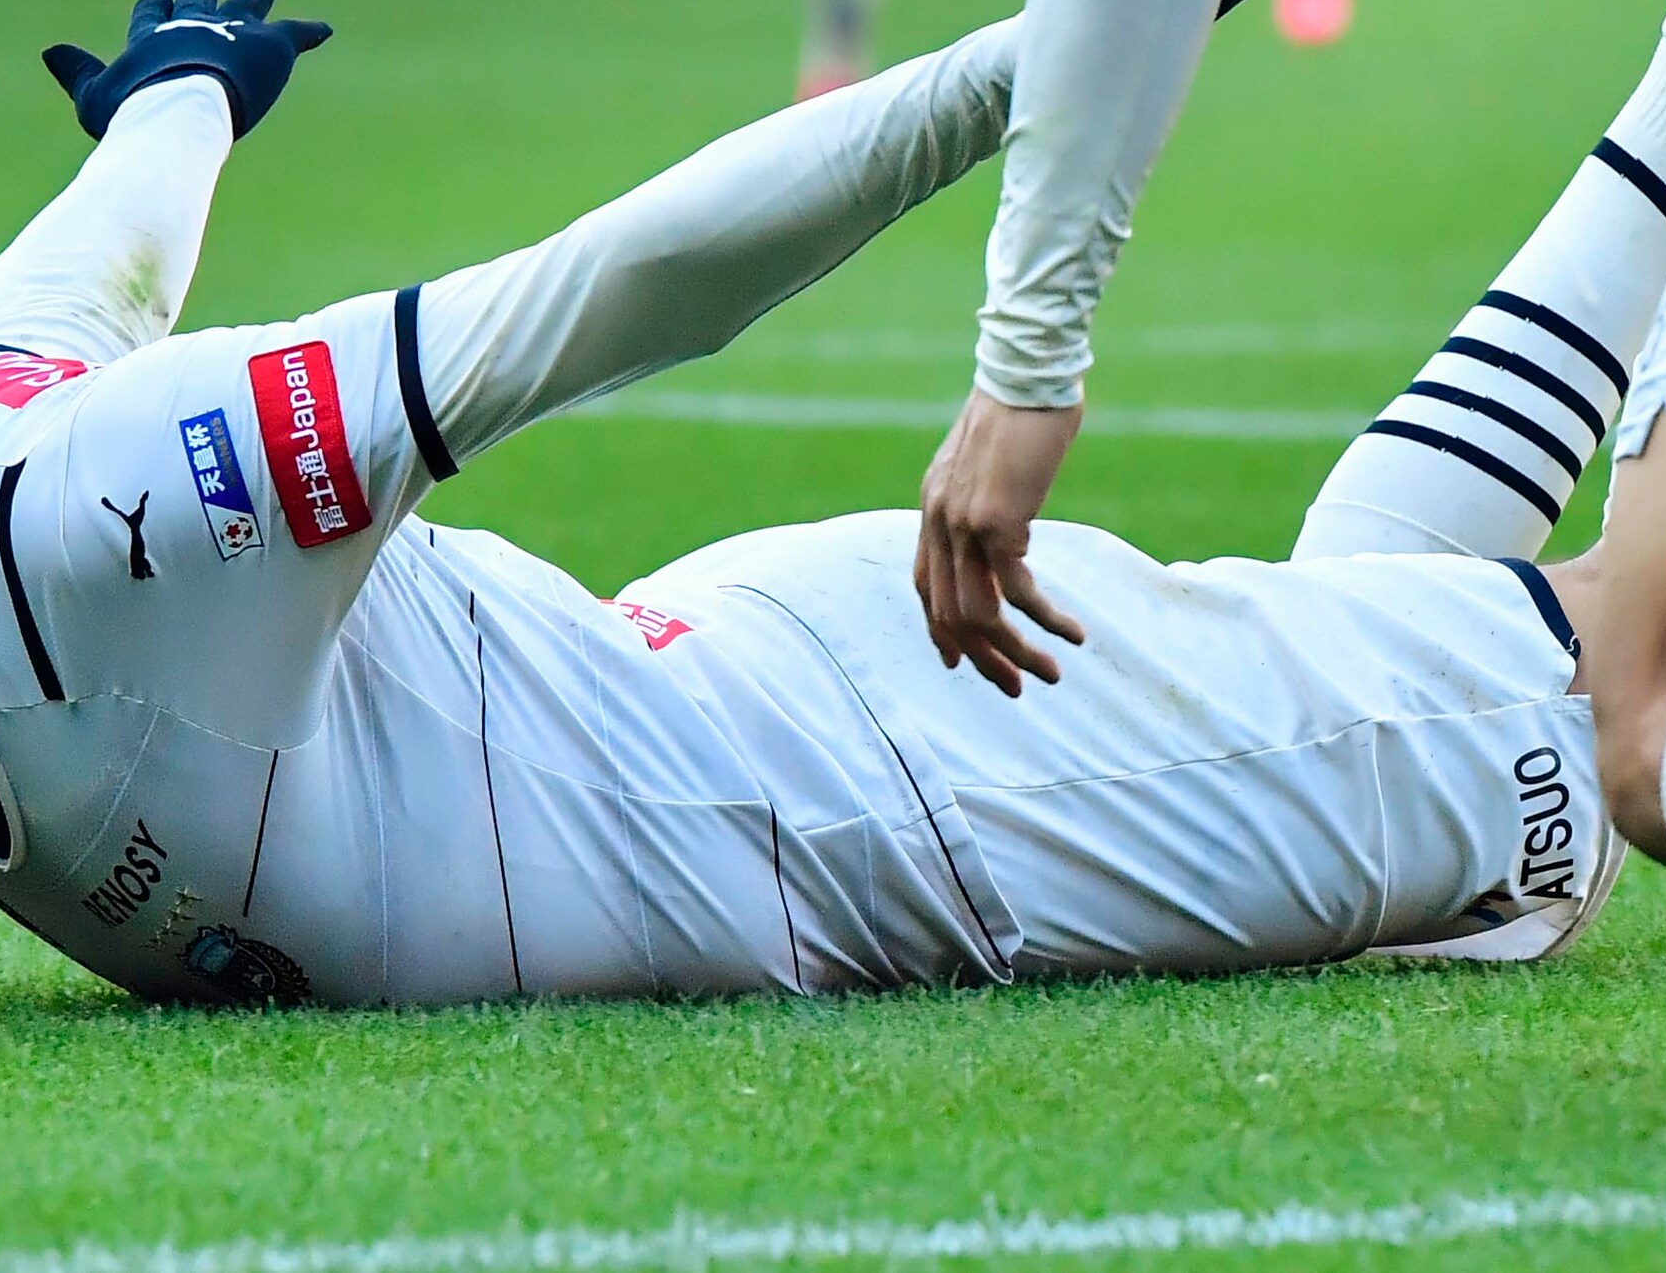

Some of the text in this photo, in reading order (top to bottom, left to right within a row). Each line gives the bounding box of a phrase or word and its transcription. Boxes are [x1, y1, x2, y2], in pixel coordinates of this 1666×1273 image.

[184, 422, 226, 498] 天皇杯
[282, 350, 348, 534] 富士通Japan
